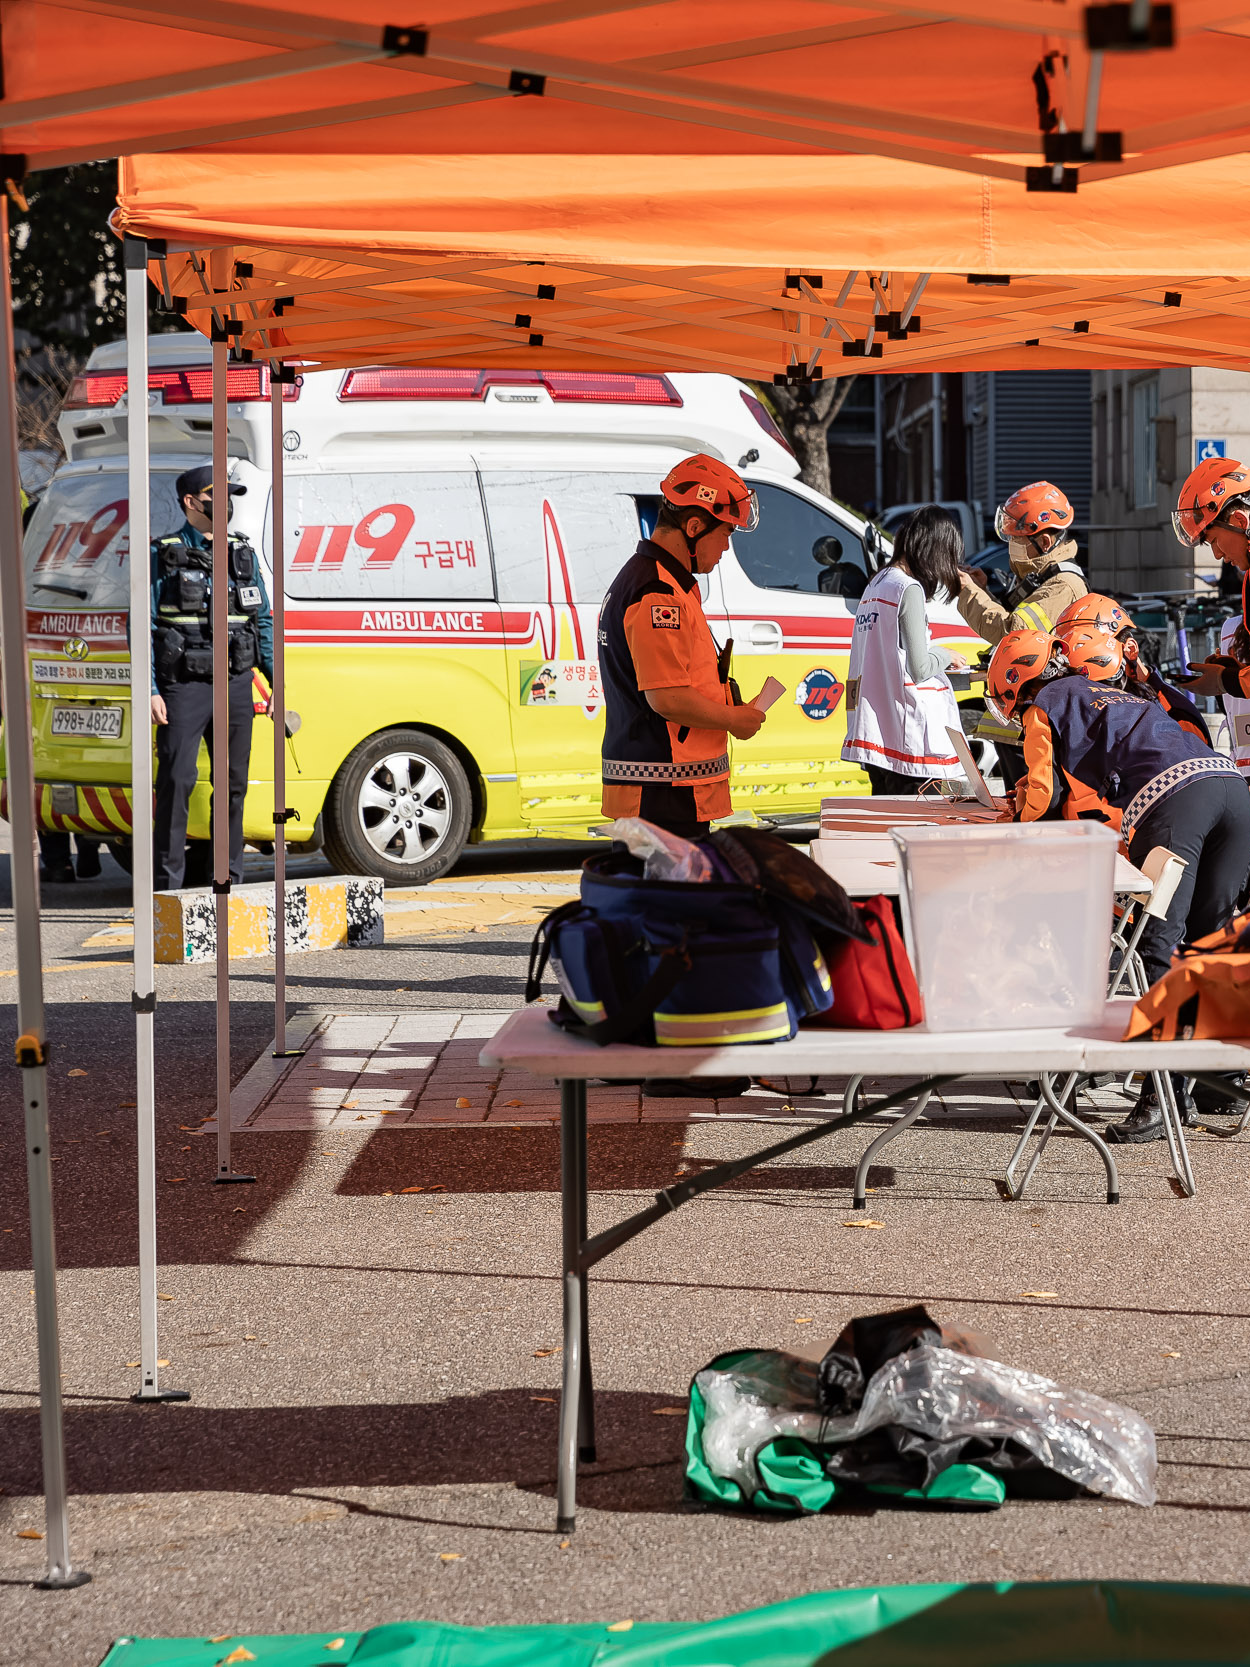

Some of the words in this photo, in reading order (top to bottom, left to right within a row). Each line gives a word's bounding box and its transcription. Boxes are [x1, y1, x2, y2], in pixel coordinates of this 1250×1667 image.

[33, 498, 129, 572] 119
[289, 504, 415, 571] 119
[415, 540, 476, 569] 구급대
[40, 615, 121, 634] AMBULANCE
[360, 611, 485, 631] AMBULANCE
[563, 665, 598, 681] 생명을
[805, 682, 845, 709] 119
[86, 711, 116, 732] 4822
